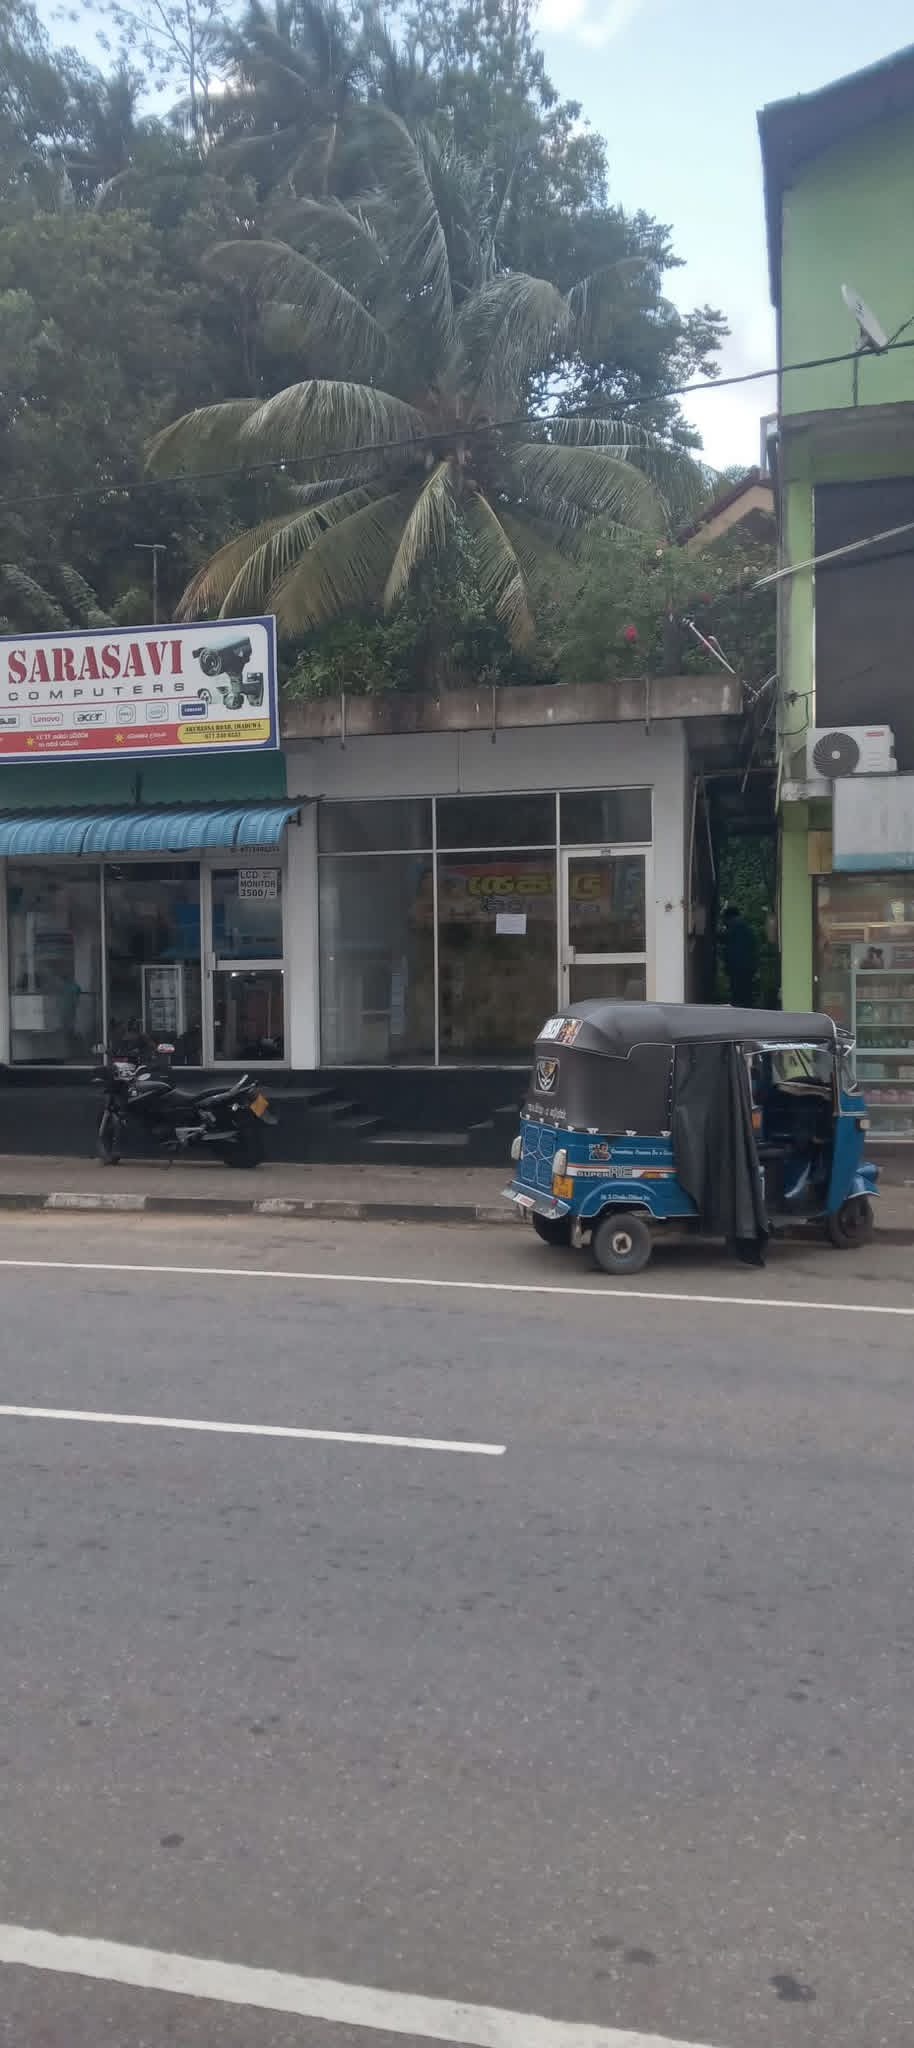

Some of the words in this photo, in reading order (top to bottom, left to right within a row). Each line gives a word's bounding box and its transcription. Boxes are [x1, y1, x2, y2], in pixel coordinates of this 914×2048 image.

[8, 640, 183, 684] SARASAVI
[8, 682, 185, 701] COMPUTERS
[33, 715, 60, 723] Lenovo
[77, 712, 103, 722] acer
[240, 871, 258, 879] LCD
[240, 879, 276, 888] MONITOR
[240, 889, 276, 898] 3500/=
